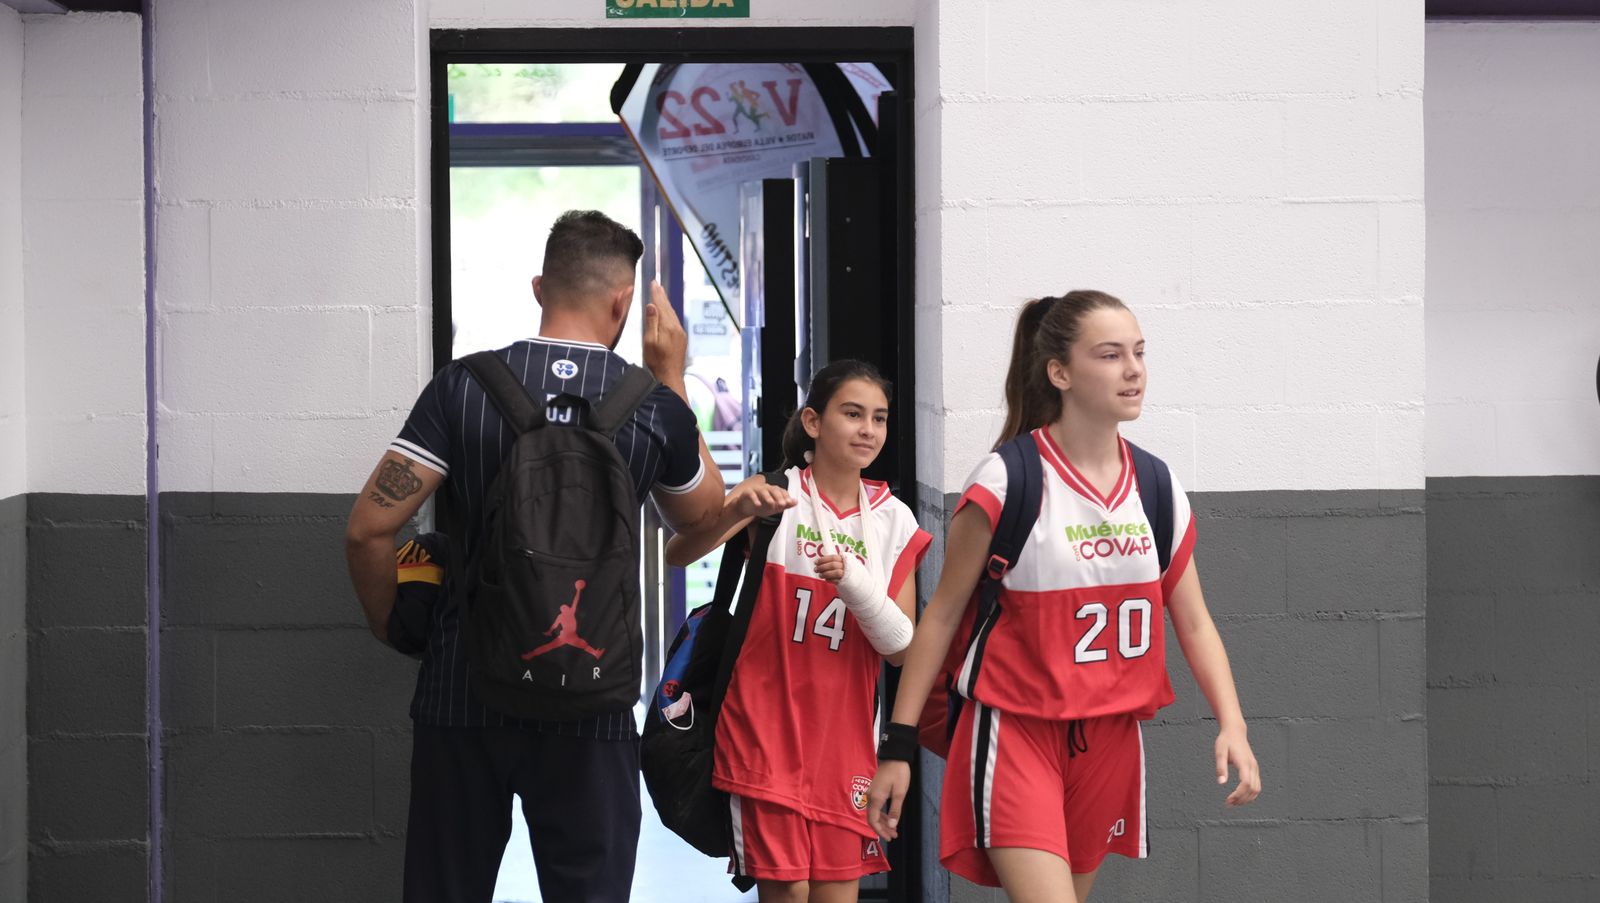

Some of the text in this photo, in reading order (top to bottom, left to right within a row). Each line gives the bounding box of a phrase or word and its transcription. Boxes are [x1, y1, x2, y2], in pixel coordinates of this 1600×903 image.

[1080, 536, 1152, 560] COVAP
[791, 587, 848, 652] 14
[1074, 597, 1153, 664] 20
